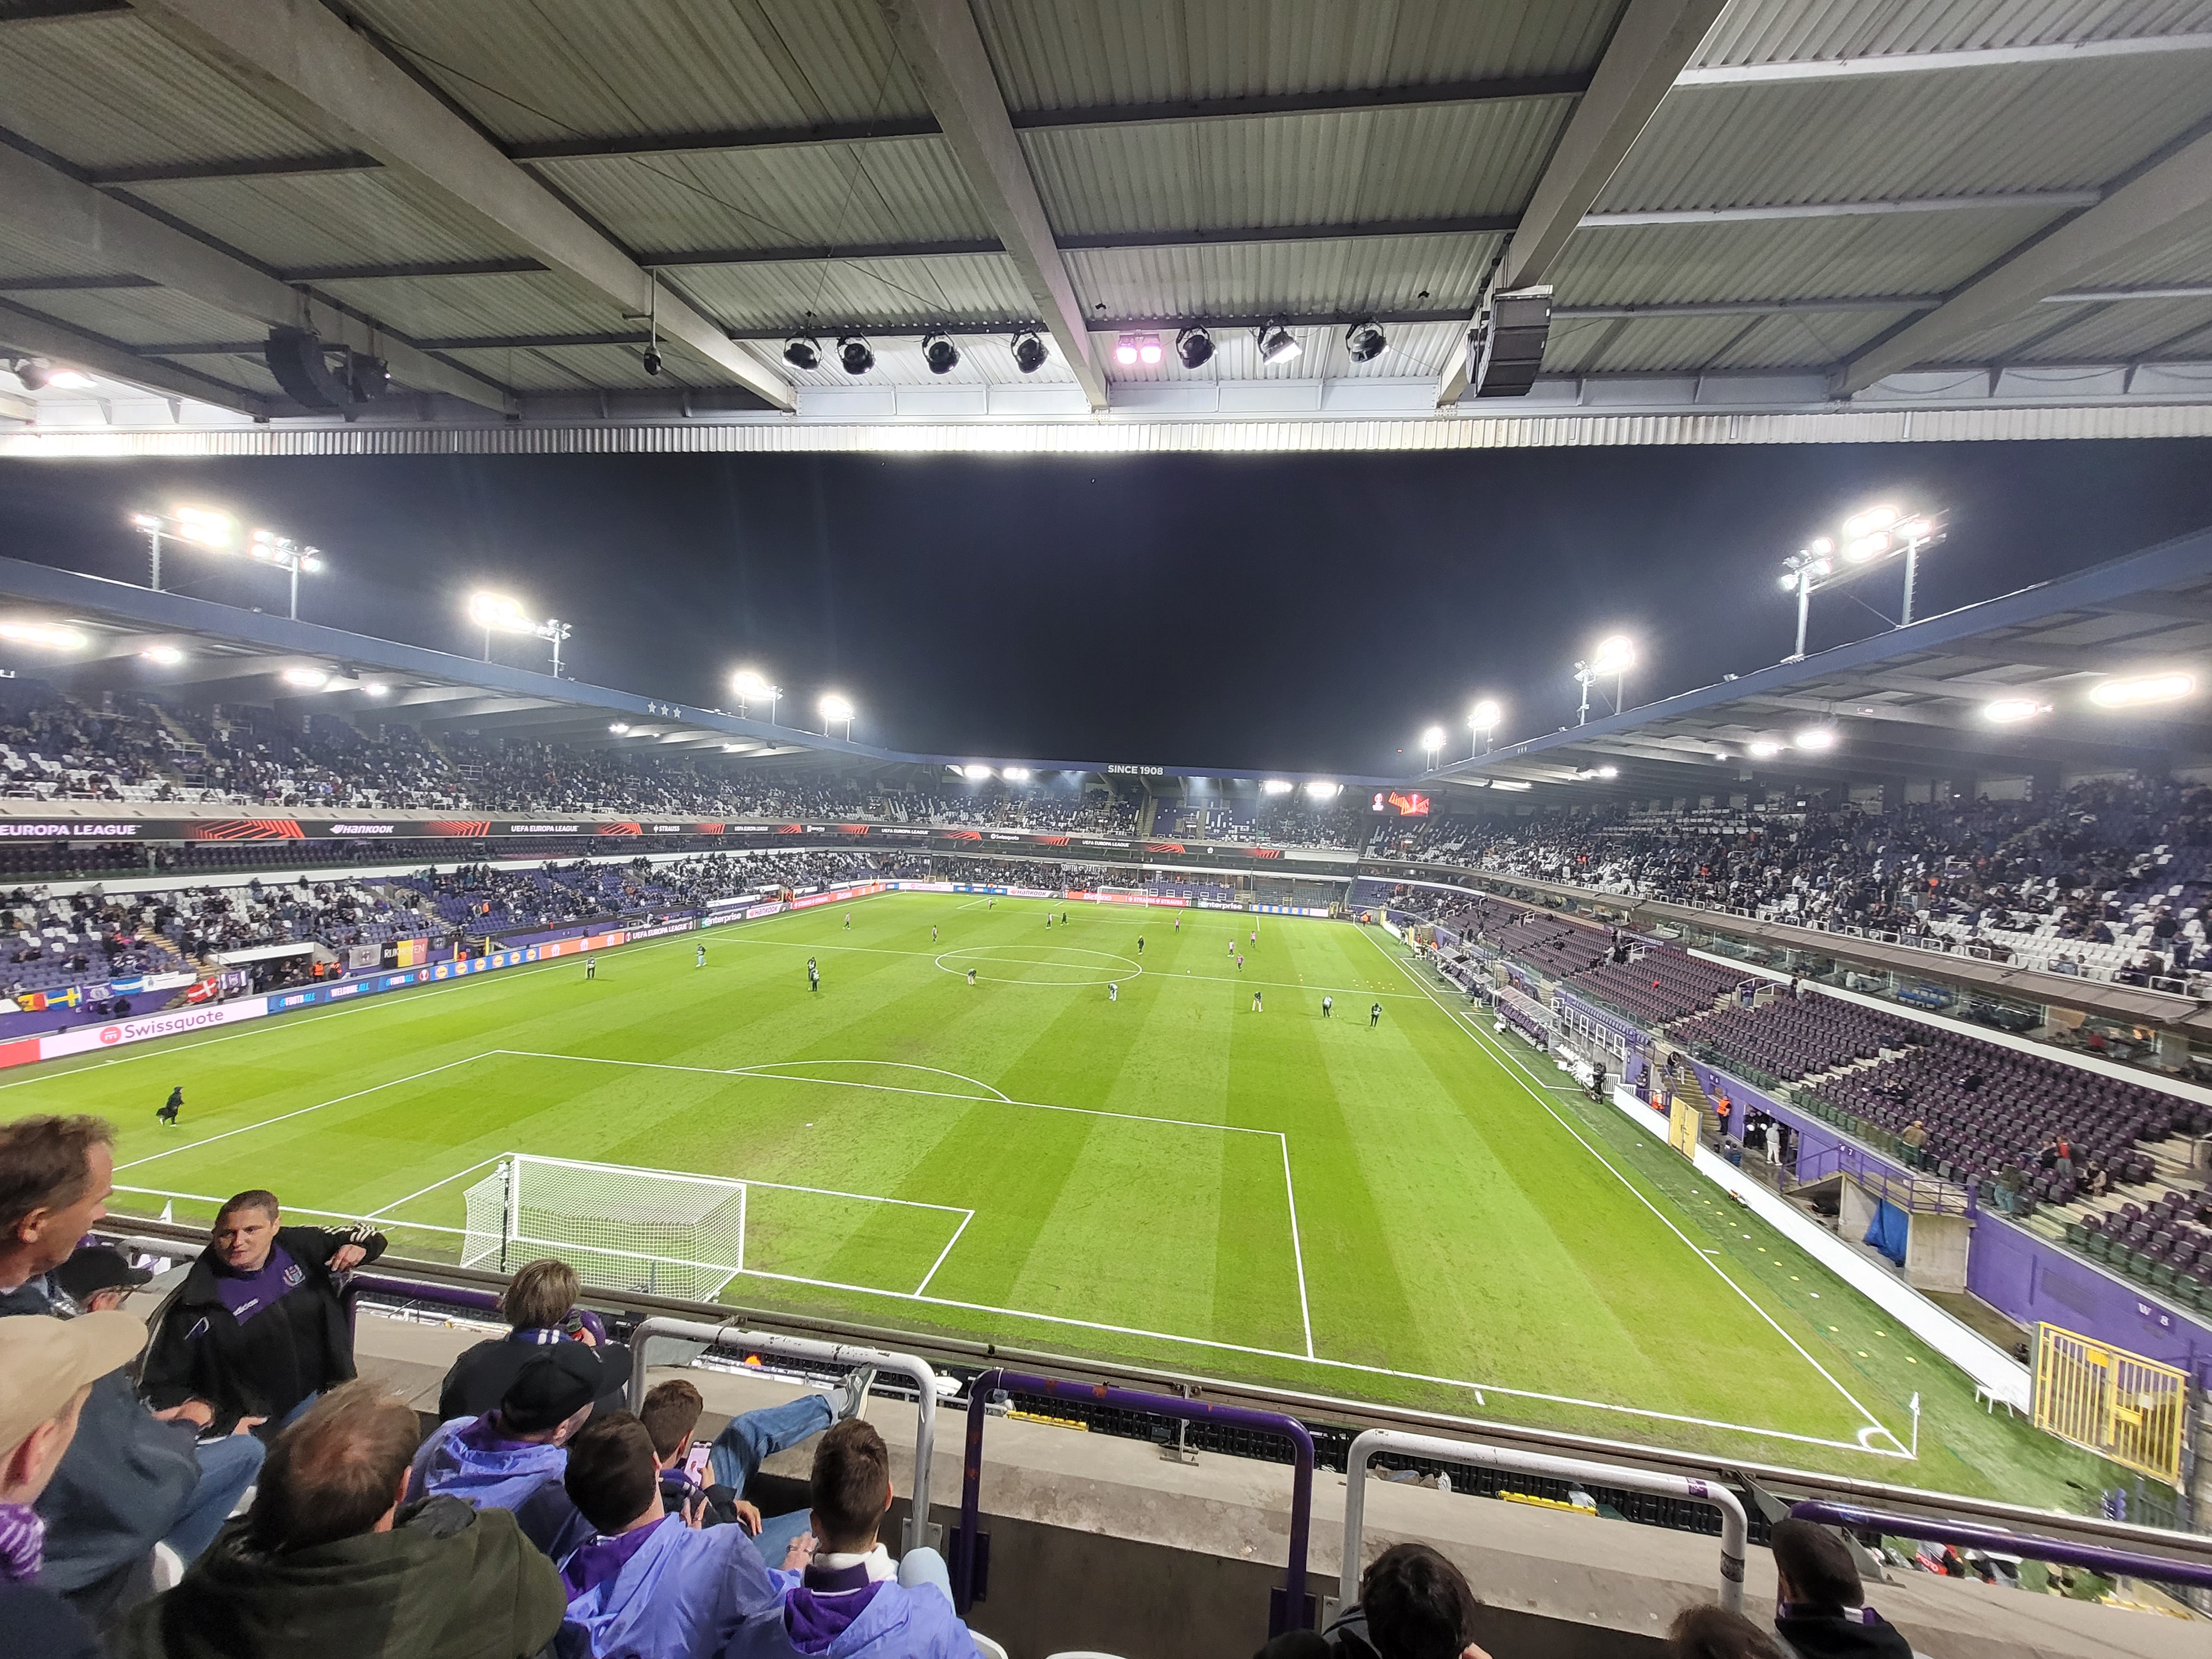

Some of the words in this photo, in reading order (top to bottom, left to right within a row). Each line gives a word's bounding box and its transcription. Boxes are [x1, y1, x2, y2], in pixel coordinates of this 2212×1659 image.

[1108, 765, 1138, 774] SINCE
[1140, 766, 1164, 775] 1908
[0, 825, 70, 836] EUROPA
[74, 825, 137, 835] LEAGUE
[1061, 863, 1078, 872] SOUTH
[1202, 901, 1243, 910] enterprise
[705, 912, 742, 925] enterprise
[632, 930, 648, 940] UEFA
[648, 926, 668, 937] EUROPA
[669, 922, 688, 933] LEAGUE
[124, 1011, 223, 1039] Swissquote
[2137, 1301, 2153, 1316] W
[2159, 1314, 2169, 1327] 8
